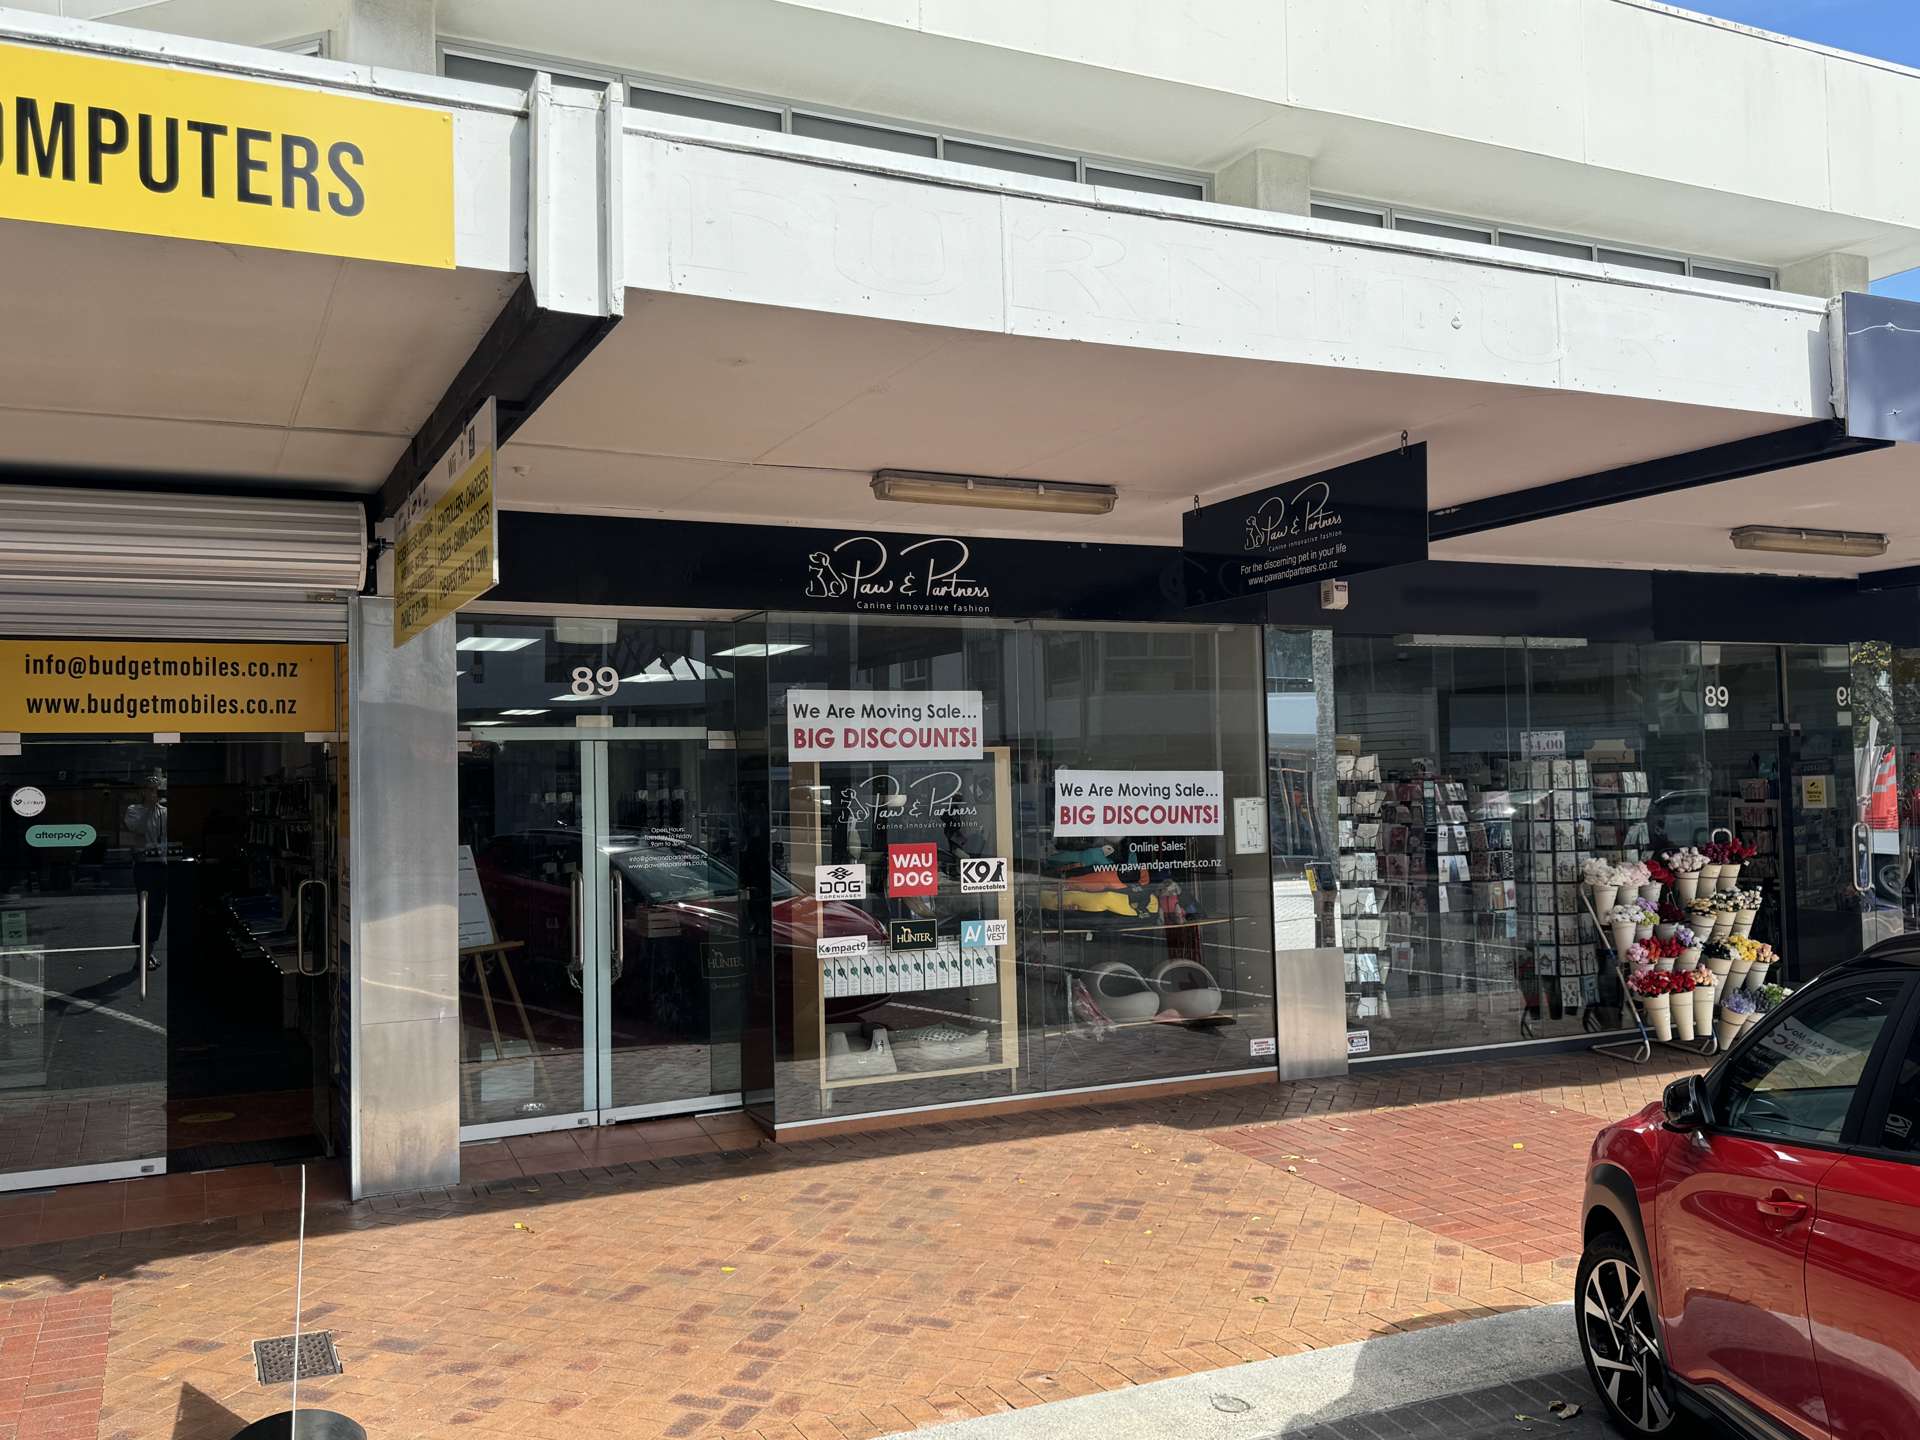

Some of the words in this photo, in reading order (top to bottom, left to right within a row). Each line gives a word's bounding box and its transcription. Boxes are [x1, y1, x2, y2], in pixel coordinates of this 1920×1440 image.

[0, 96, 365, 217] MPUTERS
[1291, 482, 1341, 532] Partners
[1258, 497, 1287, 545] Paw
[1291, 516, 1300, 535] &
[833, 537, 893, 599] Paw
[900, 538, 989, 597] Partners
[1241, 565, 1251, 575] For
[1253, 562, 1263, 573] the
[1264, 555, 1297, 570] discerning
[1298, 551, 1310, 564] pet
[1311, 551, 1317, 560] in
[1318, 546, 1334, 560] your
[1336, 543, 1347, 554] life
[1248, 560, 1338, 585] www.pawandpartners.co.nz
[900, 572, 918, 596] &
[857, 601, 892, 610] Canine
[896, 603, 949, 612] innovative
[953, 604, 990, 613] fashion
[25, 654, 298, 680] info@budgetmobiles.co.nz
[571, 666, 619, 696] 89
[26, 694, 297, 718] www.budgetmobiles.co.nz
[1704, 686, 1729, 707] 89
[793, 703, 820, 719] We
[827, 703, 855, 719] Are
[861, 703, 922, 721] Moving
[927, 703, 977, 719] Sale...
[794, 727, 835, 749] BIG
[843, 726, 977, 749] DISCOUNTS!
[860, 775, 904, 823] Paw
[910, 771, 977, 817] Partners
[1060, 783, 1083, 797] We
[1089, 783, 1113, 797] Are
[1118, 783, 1170, 800] Moving
[1175, 783, 1218, 798] Sale...
[909, 800, 922, 817] &
[1060, 805, 1095, 825] BIG
[1103, 804, 1219, 825] DISCOUNTS!
[35, 831, 76, 840] afterpay
[1129, 842, 1159, 853] Online
[1162, 841, 1186, 852] Sales:
[892, 853, 933, 868] WAU
[1093, 858, 1221, 873] www.pawandpartners.co.nz
[820, 881, 860, 893] DOG
[893, 871, 933, 887] DOG
[897, 931, 933, 943] HUNTER
[987, 924, 1005, 932] AIRY
[987, 933, 1005, 941] VEST
[819, 942, 866, 954] Kompact9
